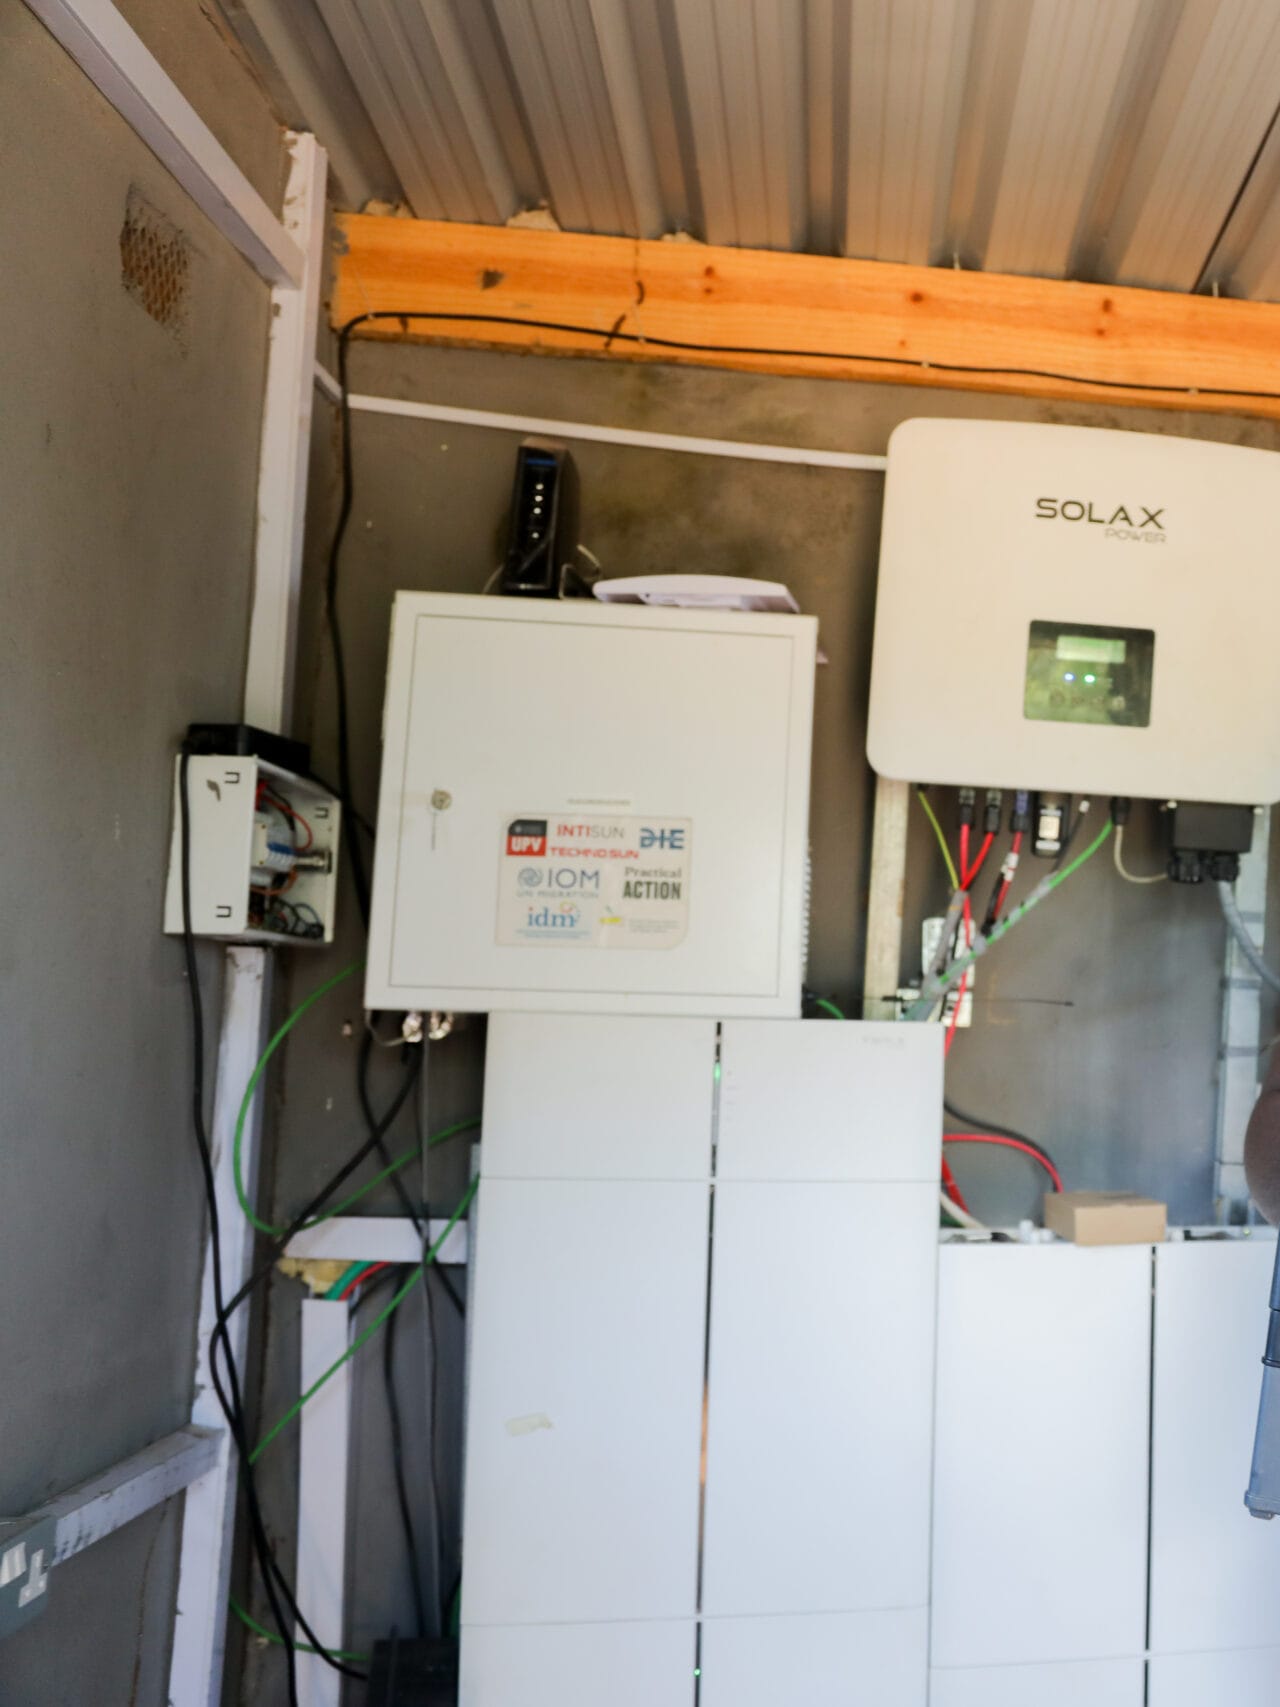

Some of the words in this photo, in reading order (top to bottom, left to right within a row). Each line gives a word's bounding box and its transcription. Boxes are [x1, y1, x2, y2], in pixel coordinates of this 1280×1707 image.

[1035, 497, 1165, 530] SOLAX
[1104, 527, 1167, 543] POWER
[511, 836, 543, 852] UPV
[547, 868, 600, 889] IOM
[624, 866, 682, 879] Practical
[622, 880, 682, 900] ACTION
[528, 906, 576, 928] idm
